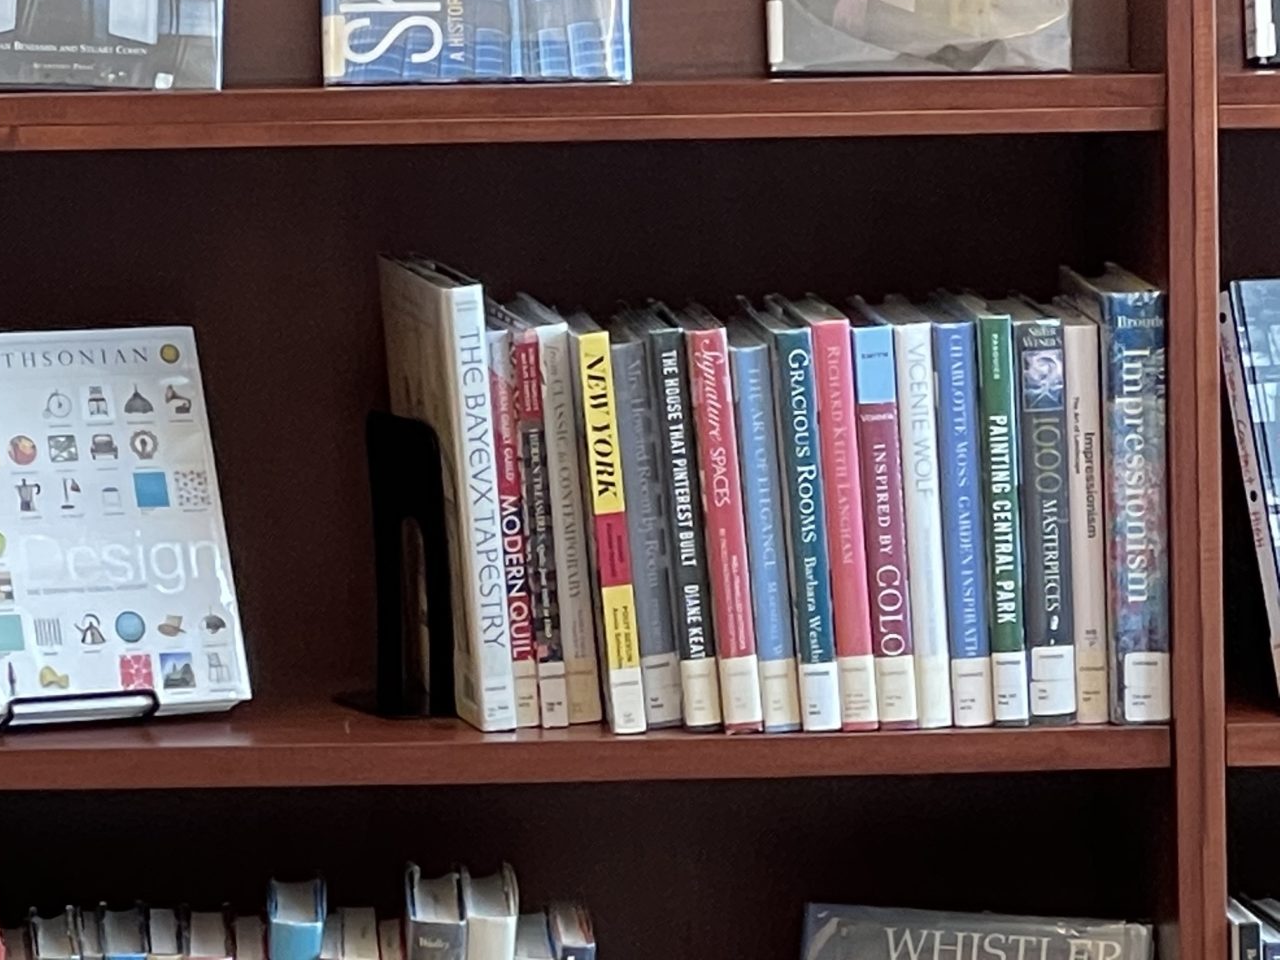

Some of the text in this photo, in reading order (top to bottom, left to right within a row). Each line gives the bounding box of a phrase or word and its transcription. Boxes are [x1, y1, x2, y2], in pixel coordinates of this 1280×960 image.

[449, 52, 464, 61] A
[460, 326, 484, 387] THE
[584, 354, 608, 414] NEW
[696, 340, 729, 507] Signature SPACES
[788, 350, 810, 458] GRACIOUS
[908, 343, 932, 498] VICENTE WOLF
[592, 421, 617, 497] YORK
[662, 351, 705, 658] THE HOUSE THAT PINTEREST BUILT DIANE KEAT
[797, 465, 816, 543] ROOMS
[824, 346, 853, 564] RICHARD KEITH LANGHAM
[989, 415, 1016, 623] PAINTING CENTRAL PARK
[1032, 417, 1062, 611] 1000 MASTERPIECES
[1082, 432, 1097, 538] Impressionism
[1116, 348, 1151, 603] Impressionism
[23, 530, 223, 595] Design
[471, 511, 505, 648] TAPESTRY
[501, 495, 533, 660] MODERN QUIL
[803, 557, 818, 611] Barbara
[872, 444, 904, 656] INSPIRED BY COLO
